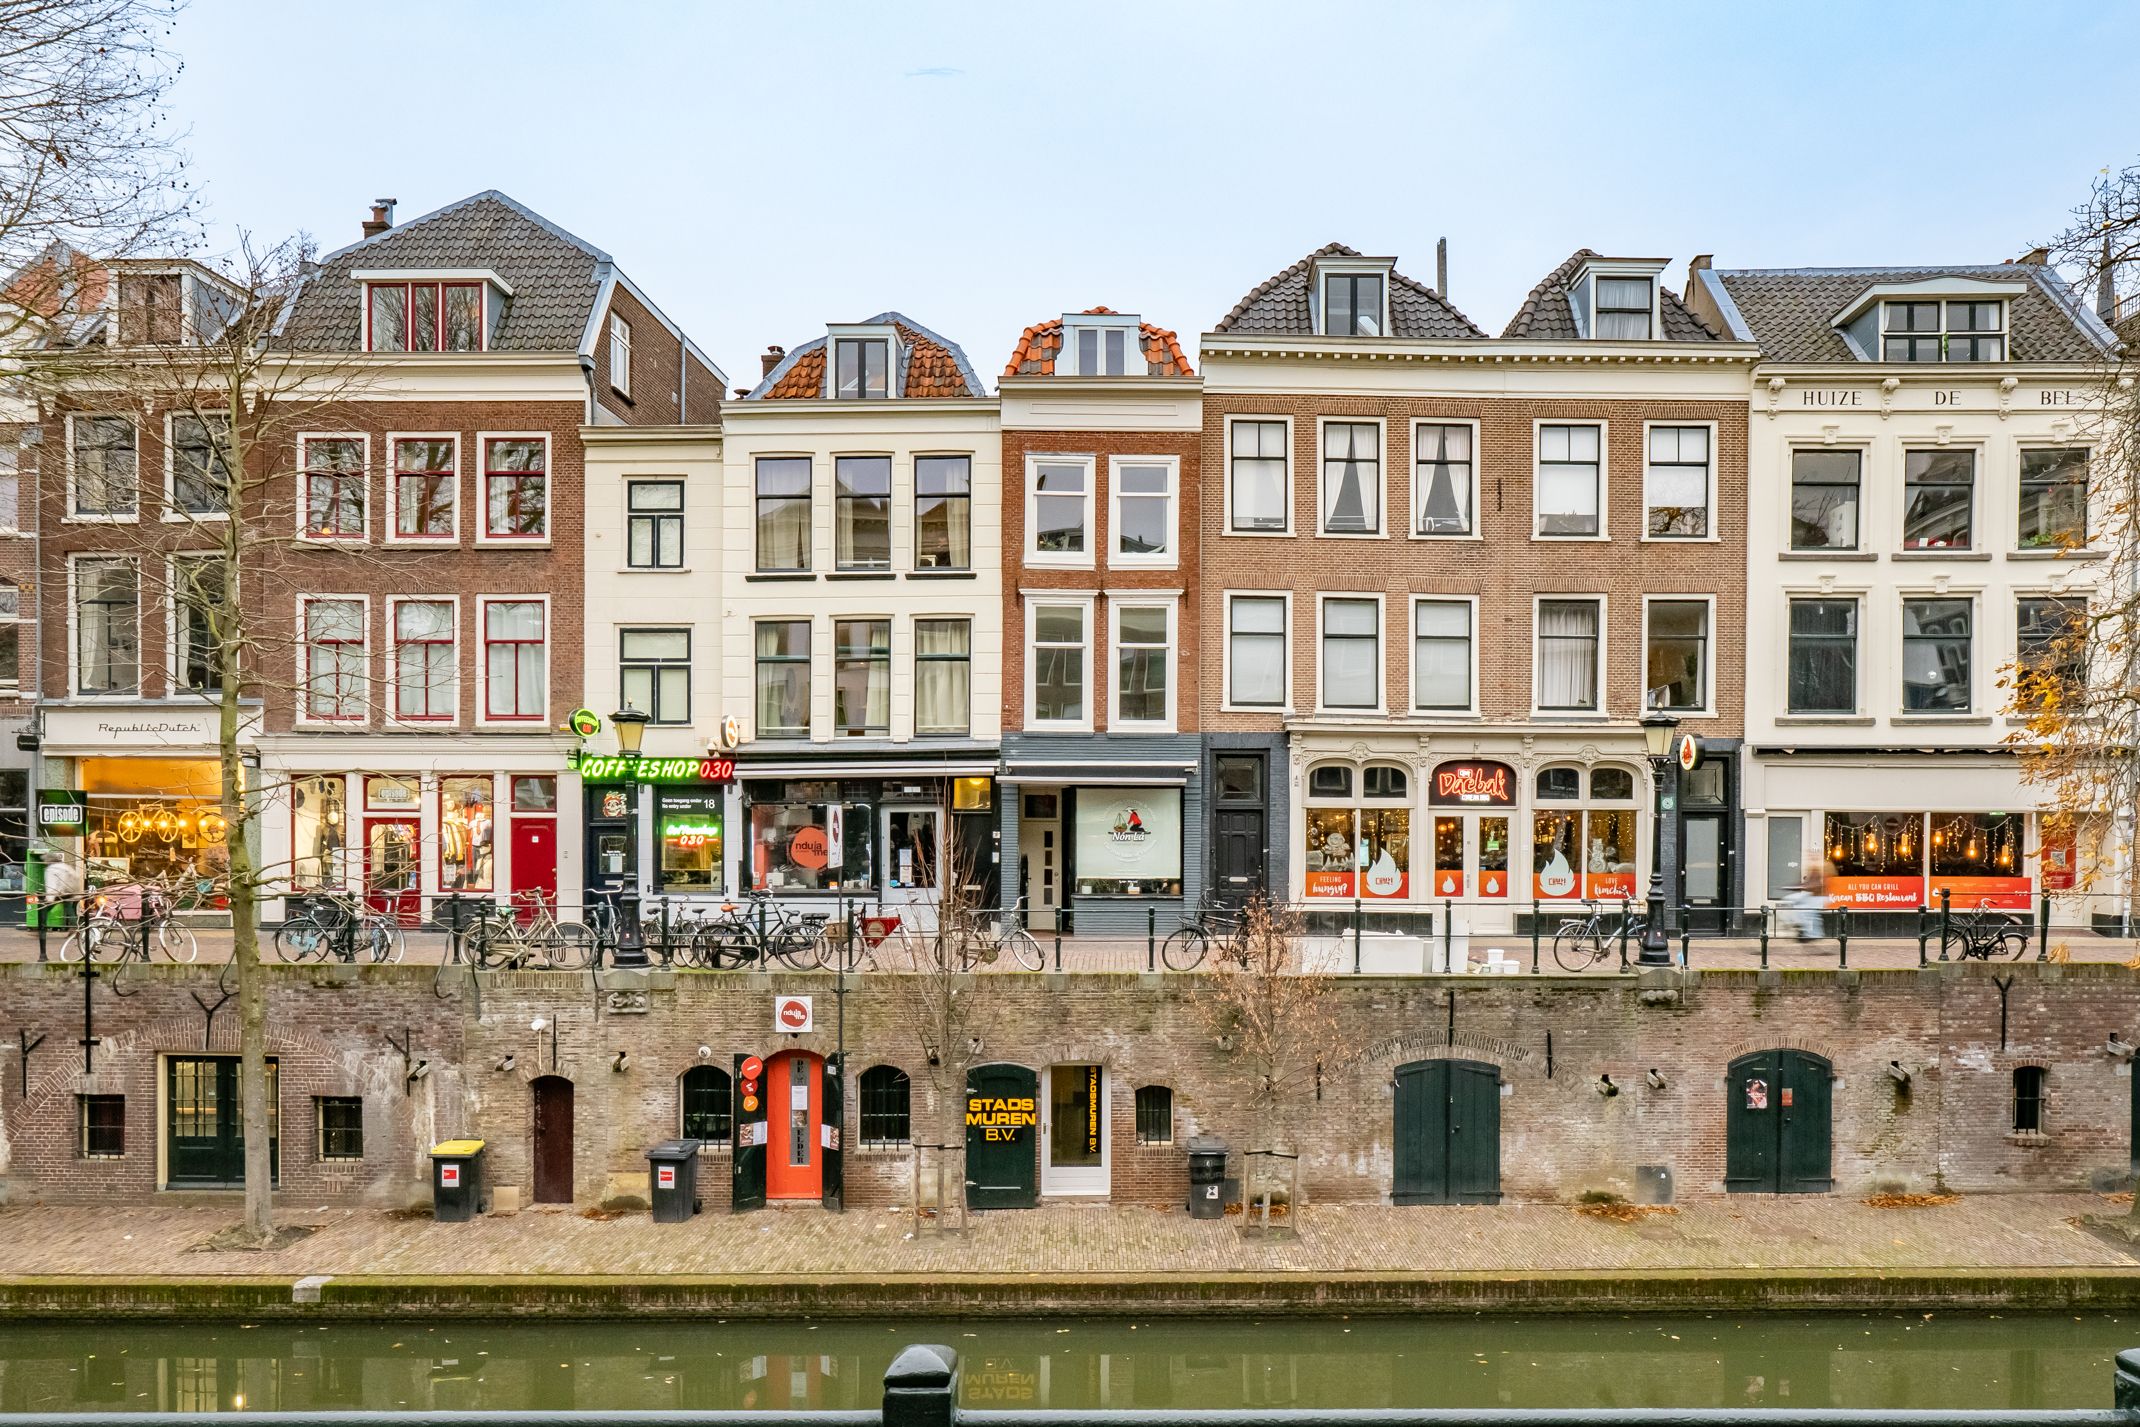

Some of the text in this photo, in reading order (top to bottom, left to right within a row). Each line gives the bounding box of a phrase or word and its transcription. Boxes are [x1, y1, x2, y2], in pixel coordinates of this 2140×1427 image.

[1803, 391, 1862, 406] HUIZE
[1935, 391, 1961, 406] DE
[98, 723, 200, 739] RepublicDutch
[700, 760, 732, 778] 030
[1439, 768, 1508, 801] Daebak
[703, 799, 716, 809] 18
[43, 806, 79, 822] episode
[680, 835, 705, 845] 030
[1312, 882, 1348, 896] hungry?
[1848, 883, 1899, 891] ALL YOU CAN GRILL
[1876, 892, 1917, 902] Restaurant
[969, 1098, 1035, 1112] STADS
[1089, 1066, 1097, 1136] STADSMUREN
[965, 1112, 1036, 1126] MUREN
[985, 1129, 1016, 1141] B.V.
